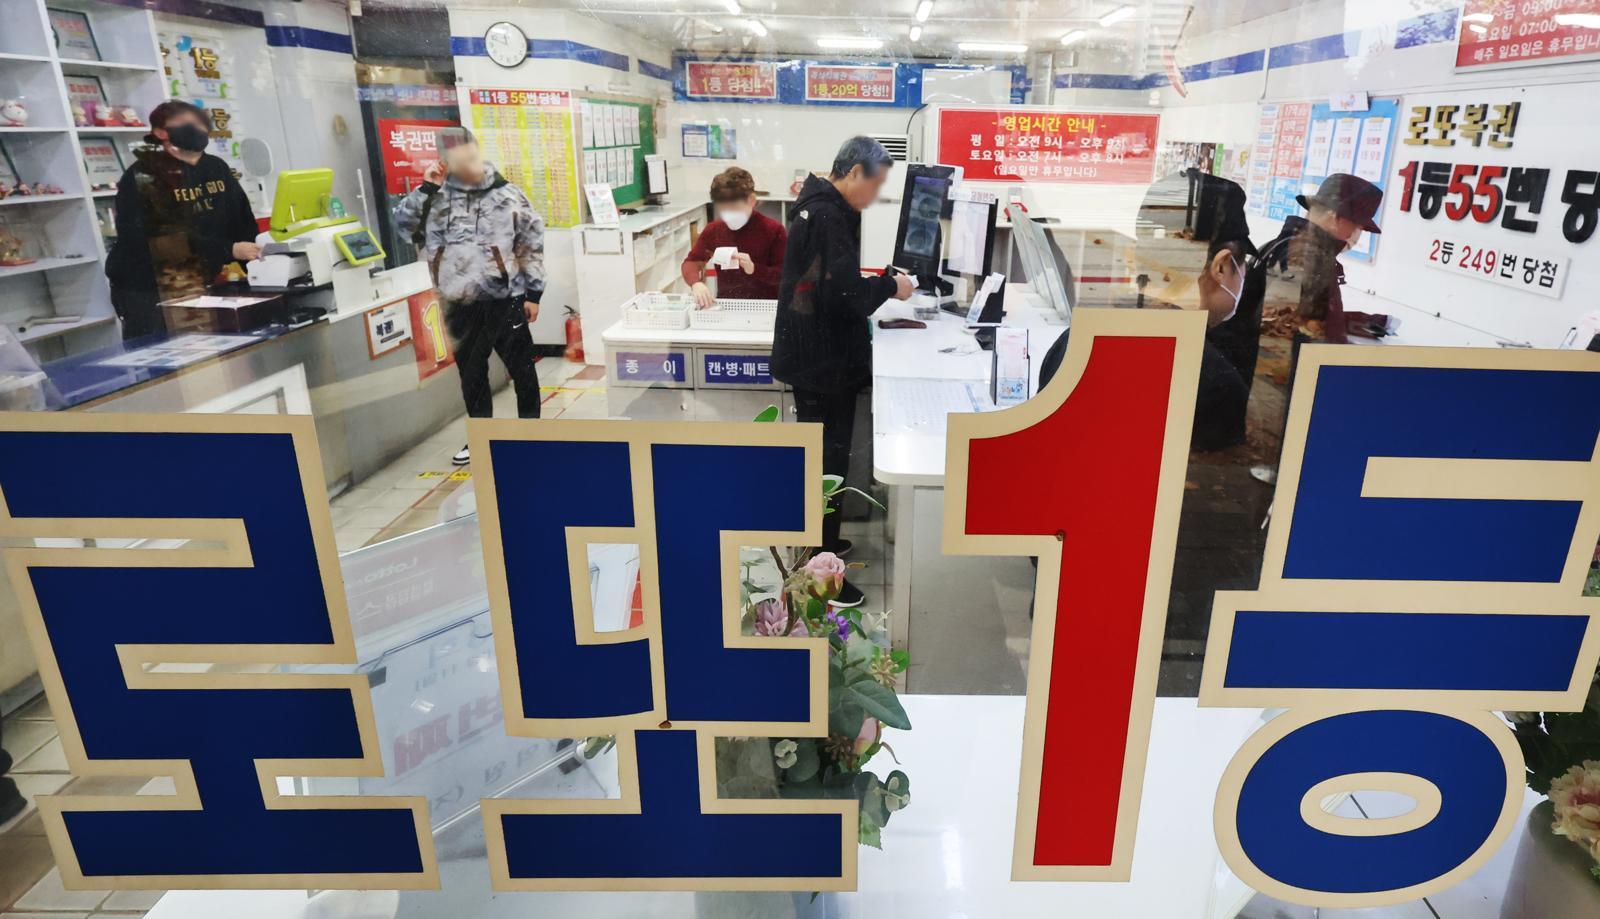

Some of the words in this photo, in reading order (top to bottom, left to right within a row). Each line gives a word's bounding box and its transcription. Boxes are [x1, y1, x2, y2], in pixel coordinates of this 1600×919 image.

[1499, 41, 1543, 59] 일요일은
[1003, 116, 1061, 131] 영업시간
[1067, 118, 1095, 133] 안내
[1403, 101, 1521, 148] 로또복권
[970, 134, 982, 147] 평
[994, 135, 1005, 147] 일
[1016, 136, 1040, 148] 오전
[1044, 136, 1062, 148] 9시
[1079, 138, 1103, 149] 오후
[969, 150, 1005, 162] 토요일
[1017, 151, 1039, 163] 오전
[1043, 152, 1062, 163] 7시
[1079, 153, 1101, 164] 오후
[1429, 239, 1454, 264] 2등
[1523, 257, 1557, 288] 당첨
